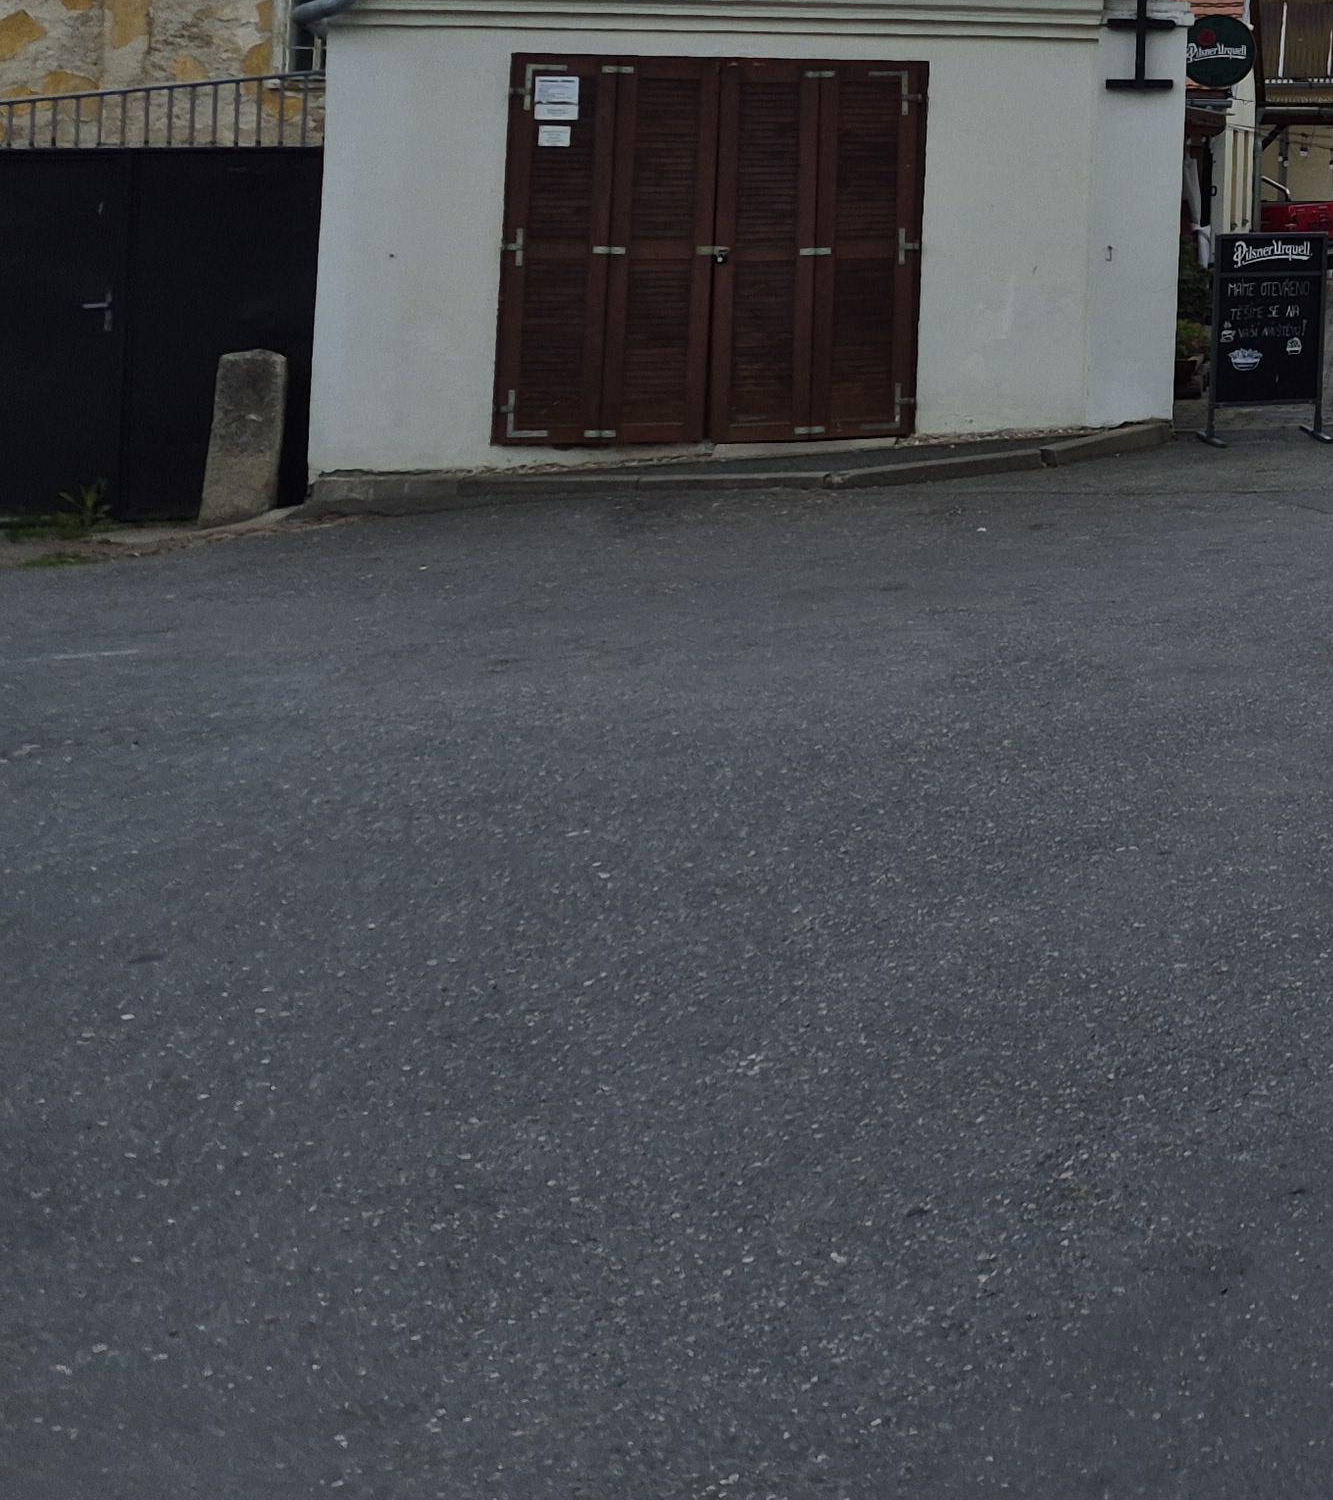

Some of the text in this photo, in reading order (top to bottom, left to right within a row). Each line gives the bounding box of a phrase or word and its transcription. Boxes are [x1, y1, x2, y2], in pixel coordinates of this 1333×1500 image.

[1232, 239, 1311, 269] Pilsner Urquell
[1267, 304, 1280, 318] SE
[1285, 304, 1300, 318] NA
